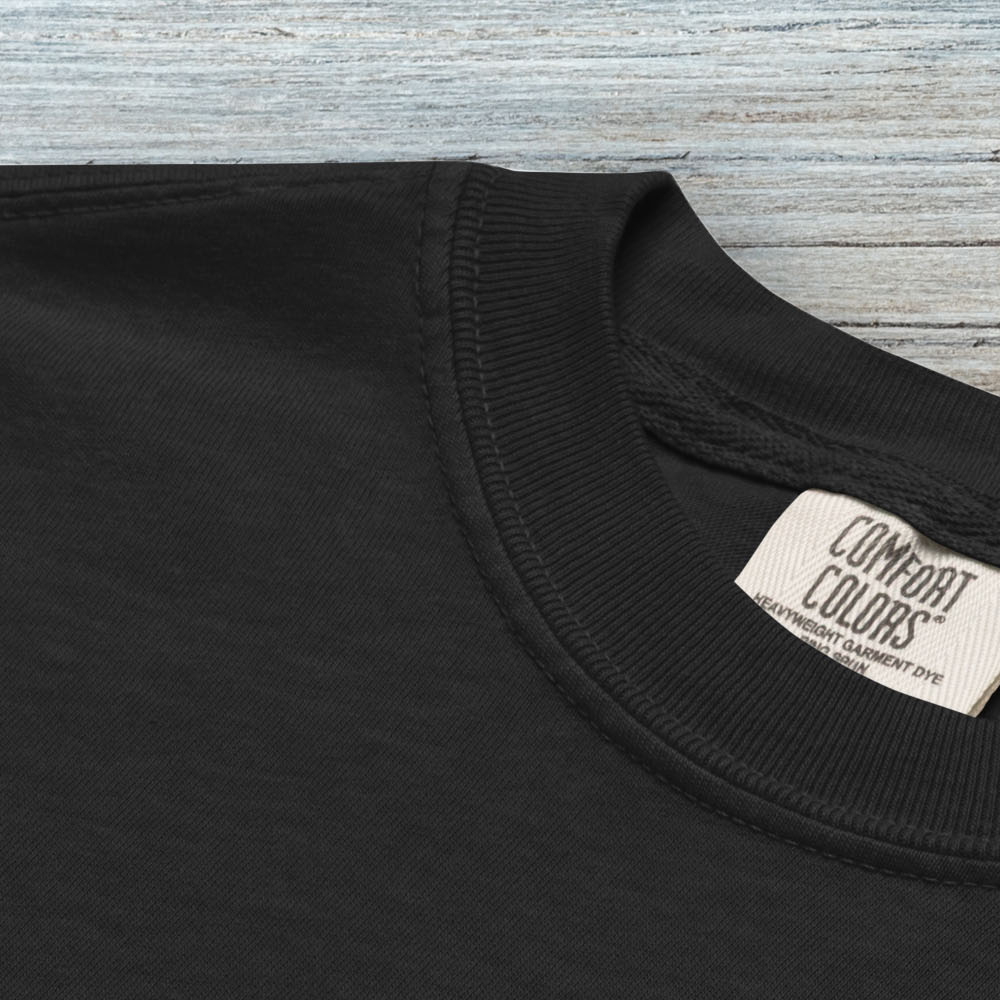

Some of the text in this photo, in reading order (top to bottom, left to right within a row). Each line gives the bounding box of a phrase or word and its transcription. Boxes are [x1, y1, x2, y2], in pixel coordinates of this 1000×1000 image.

[828, 515, 978, 613] COMFORT
[753, 592, 846, 644] HEAVYWEIGHT
[842, 639, 914, 672] GARMENT
[911, 668, 945, 685] DYE
